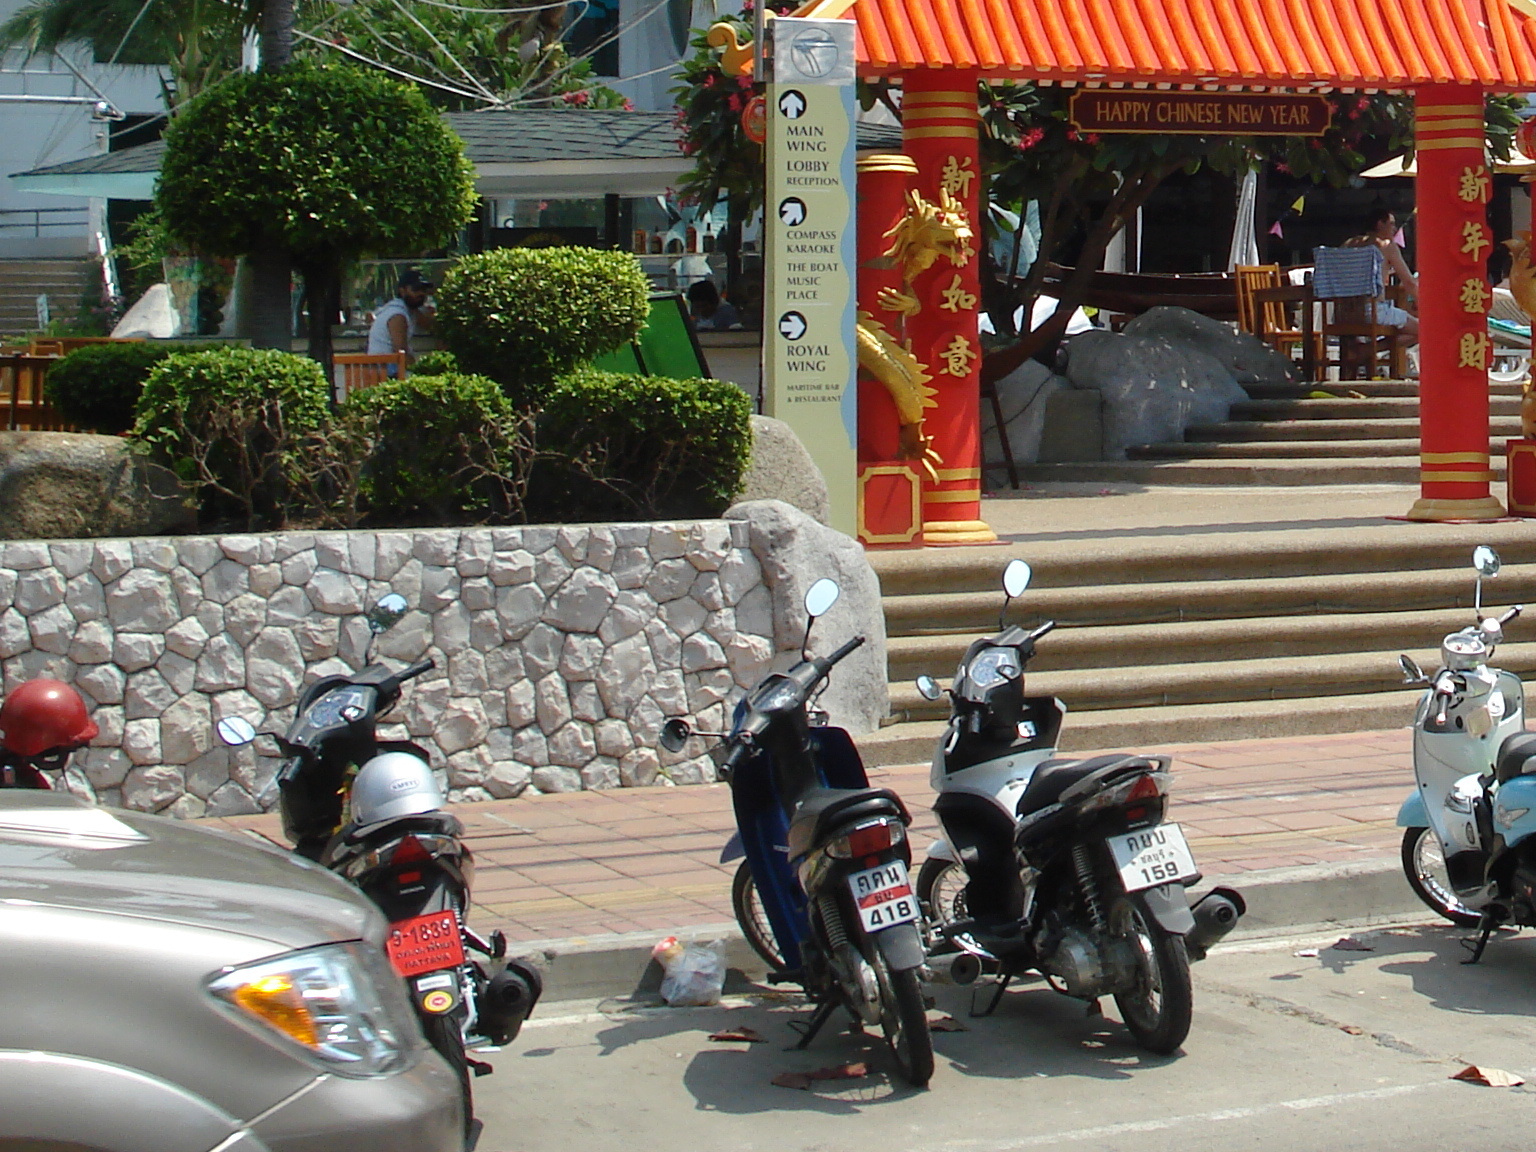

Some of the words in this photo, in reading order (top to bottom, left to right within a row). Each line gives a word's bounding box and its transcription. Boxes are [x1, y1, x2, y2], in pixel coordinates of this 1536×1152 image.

[1097, 101, 1150, 122] HAPPY
[1157, 102, 1222, 123] CHINESE
[1228, 104, 1264, 124] NEW
[1270, 105, 1310, 125] YEAR
[786, 125, 824, 137] MAIN
[786, 140, 827, 153] WING
[786, 160, 830, 172] LOBBY
[786, 176, 839, 186] RECEPTION
[786, 230, 837, 240] COMPASS
[786, 244, 836, 254] KARAOKE
[786, 262, 807, 272] THE
[810, 262, 839, 272] BOAT
[939, 155, 977, 378] 新如意
[1457, 164, 1491, 372] 新年發財
[786, 276, 821, 286] MUSIC
[786, 290, 818, 300] PLACE
[786, 344, 830, 357] ROYAL
[786, 360, 826, 372] WING
[1140, 848, 1166, 864] ชลบุรี
[1141, 861, 1179, 883] 159
[871, 900, 911, 926] 418
